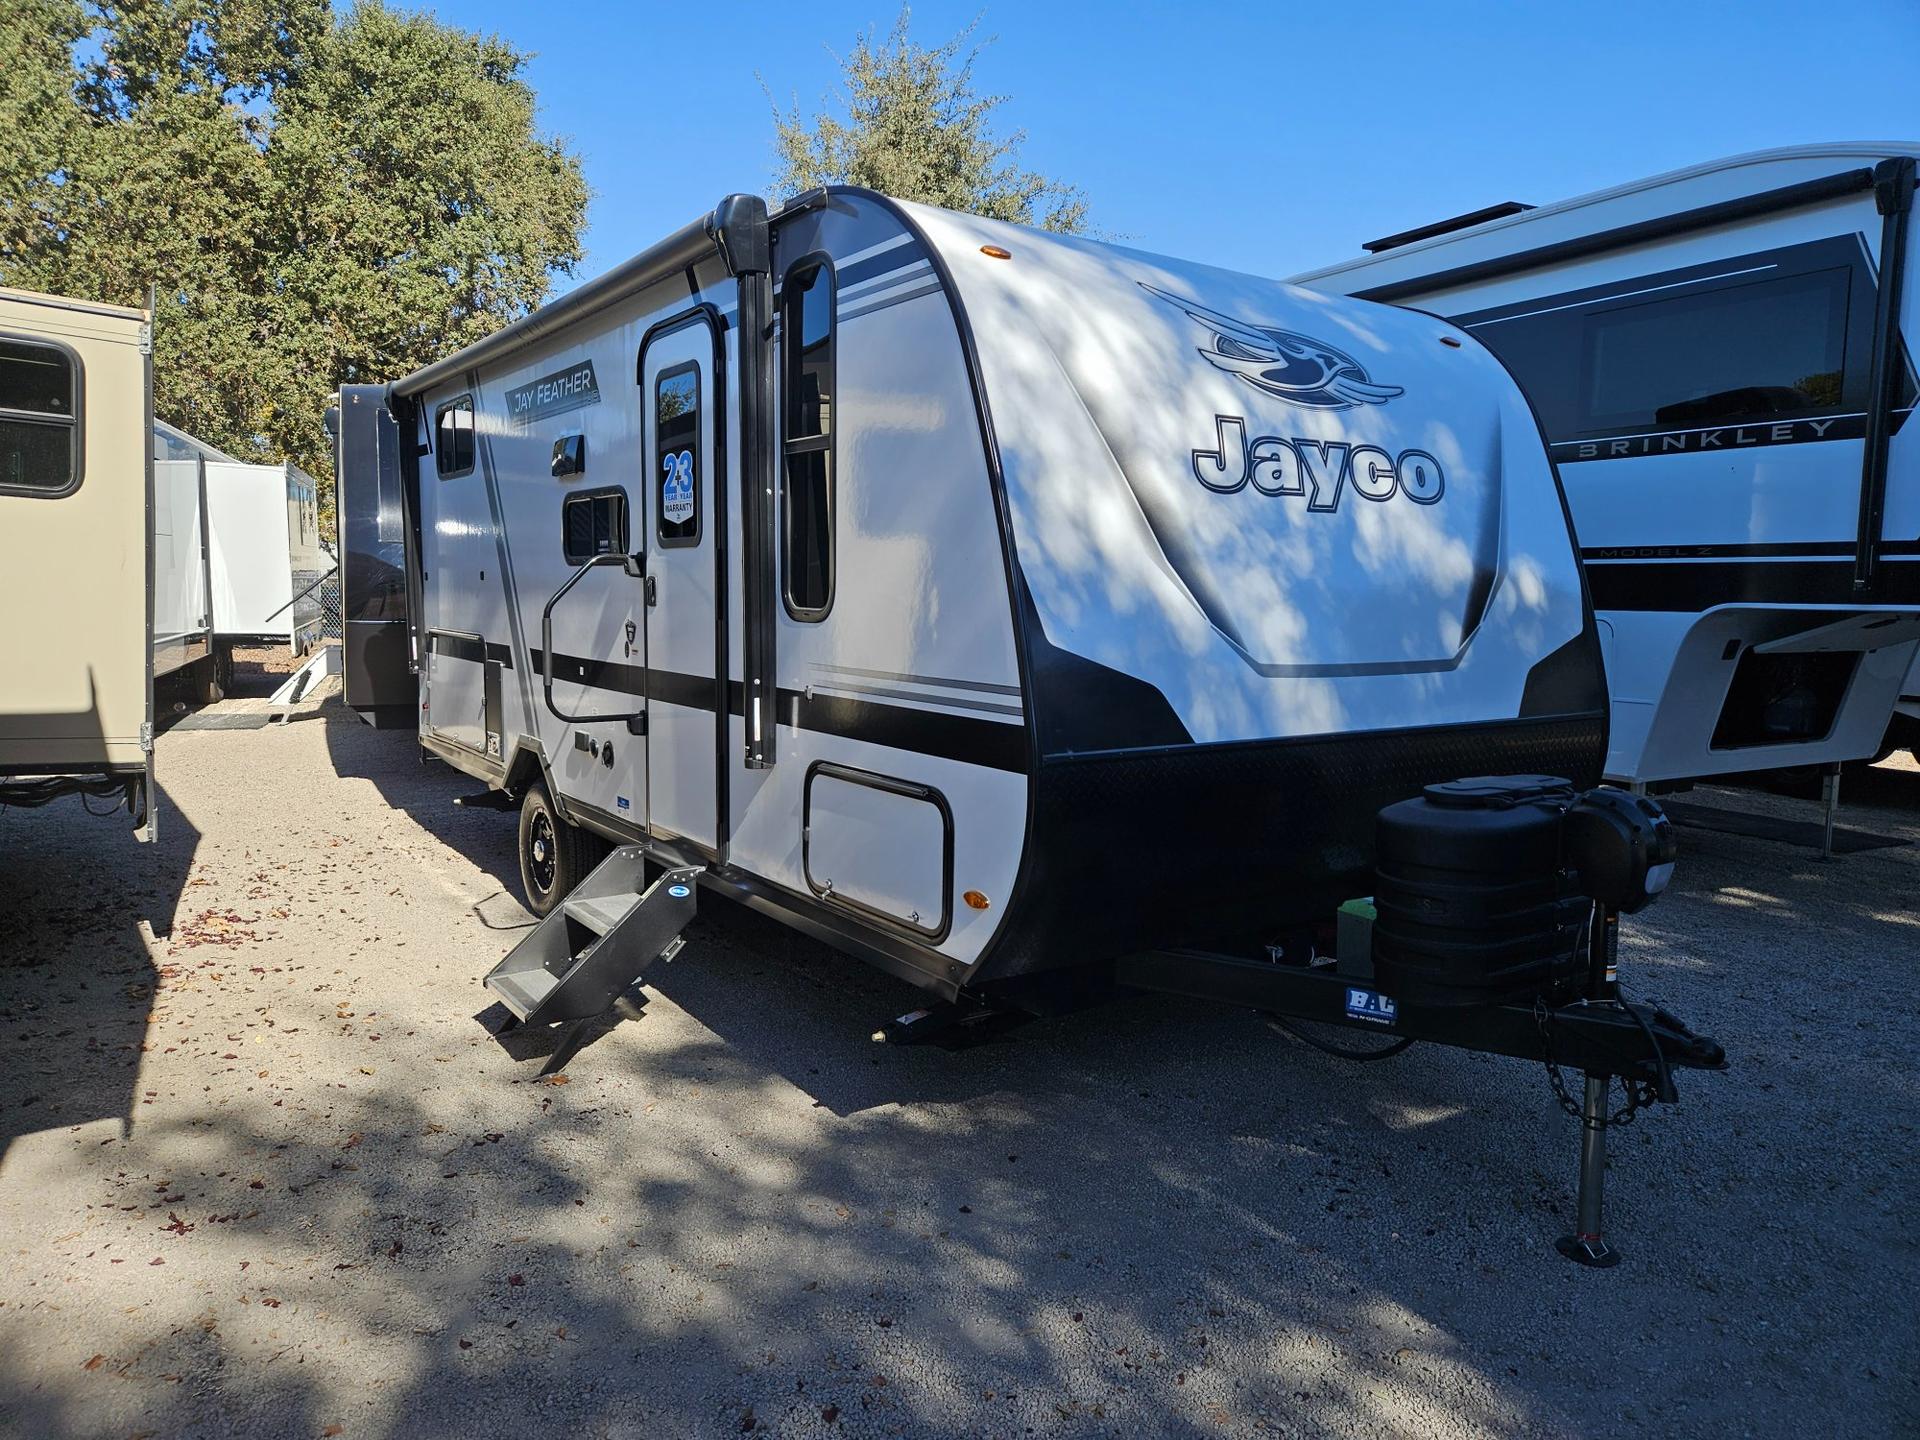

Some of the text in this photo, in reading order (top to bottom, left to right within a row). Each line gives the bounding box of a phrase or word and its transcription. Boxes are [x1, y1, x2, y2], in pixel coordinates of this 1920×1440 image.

[515, 390, 534, 412] JAY
[537, 369, 591, 405] FEATHER
[1579, 420, 1835, 458] BRINKLEY
[1192, 414, 1445, 513] Jayco
[665, 502, 692, 512] WARRANTY
[1600, 547, 1713, 557] MODEL Z
